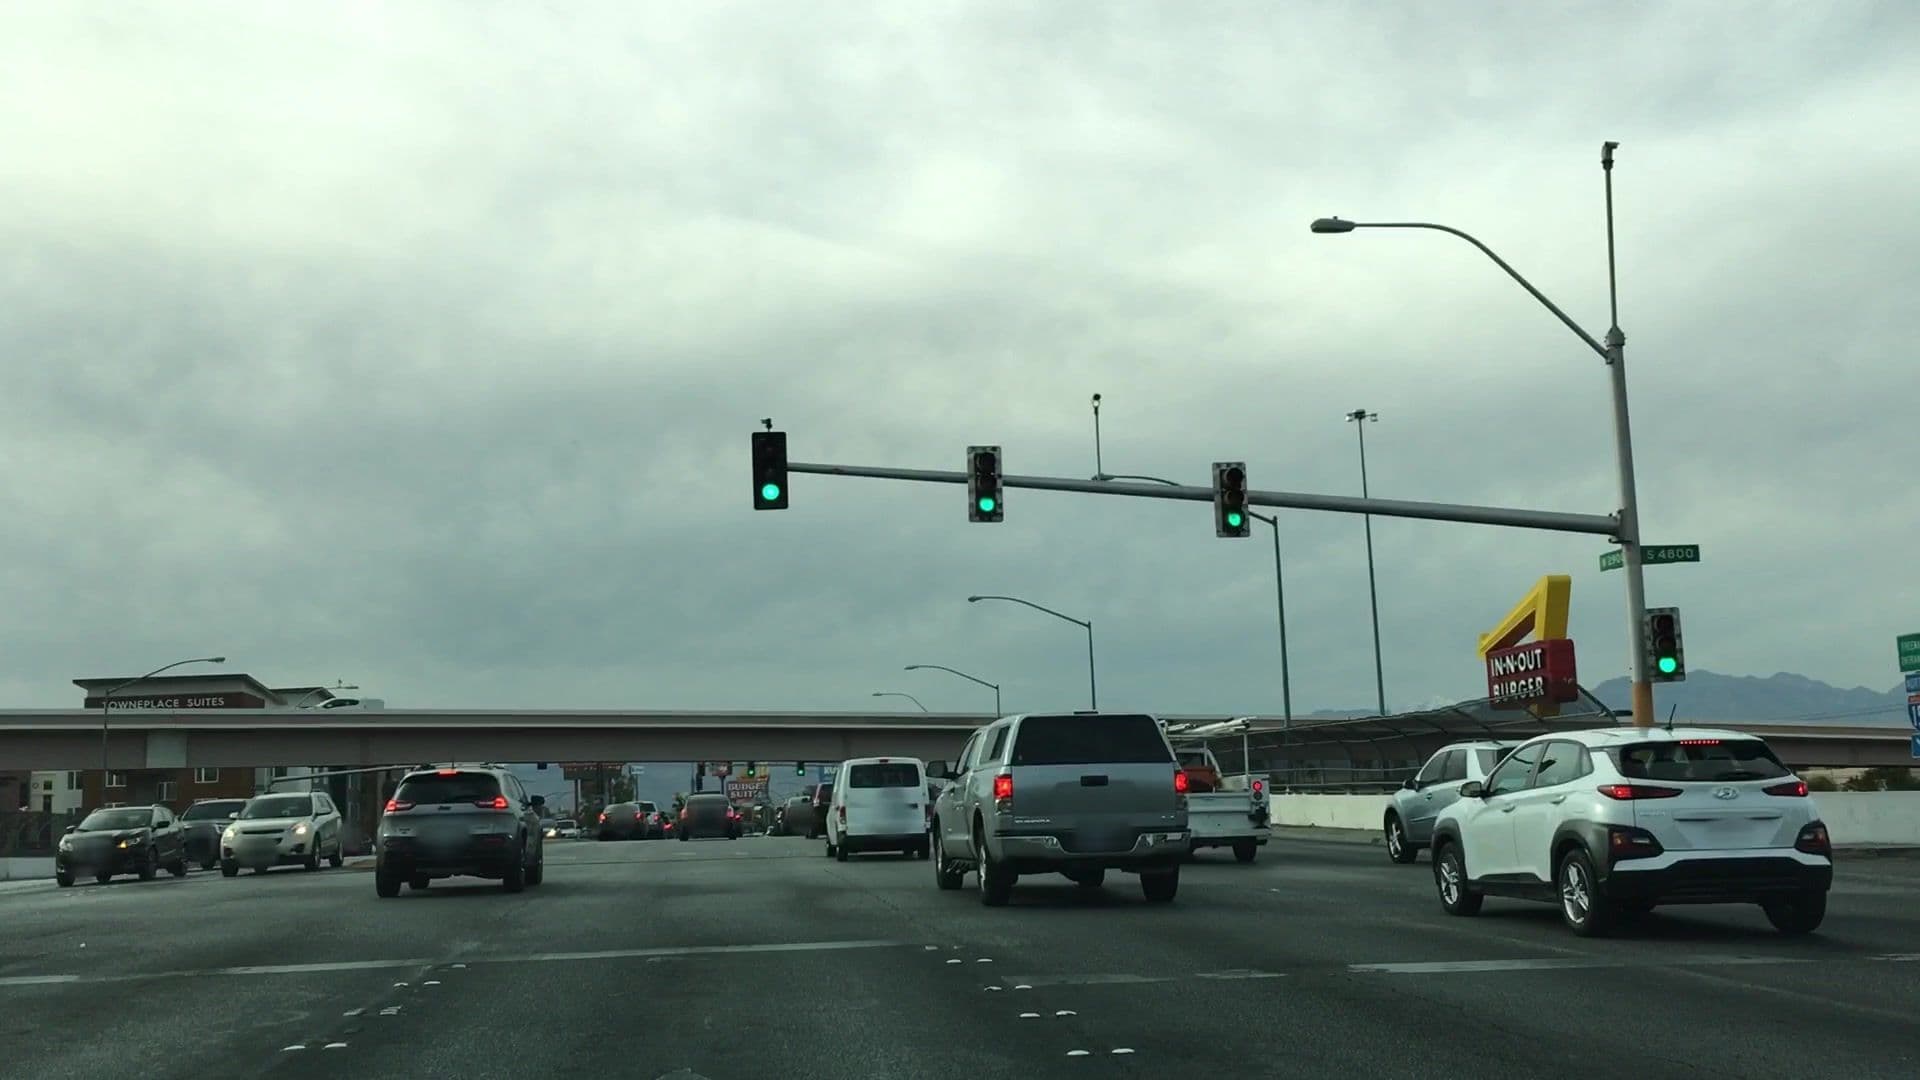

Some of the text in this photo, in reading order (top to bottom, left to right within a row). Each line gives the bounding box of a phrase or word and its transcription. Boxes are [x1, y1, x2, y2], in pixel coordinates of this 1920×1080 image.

[1647, 548, 1694, 560] S 4800
[1492, 676, 1545, 704] BURGER
[102, 697, 225, 710] TOWNEPLACE SUITES
